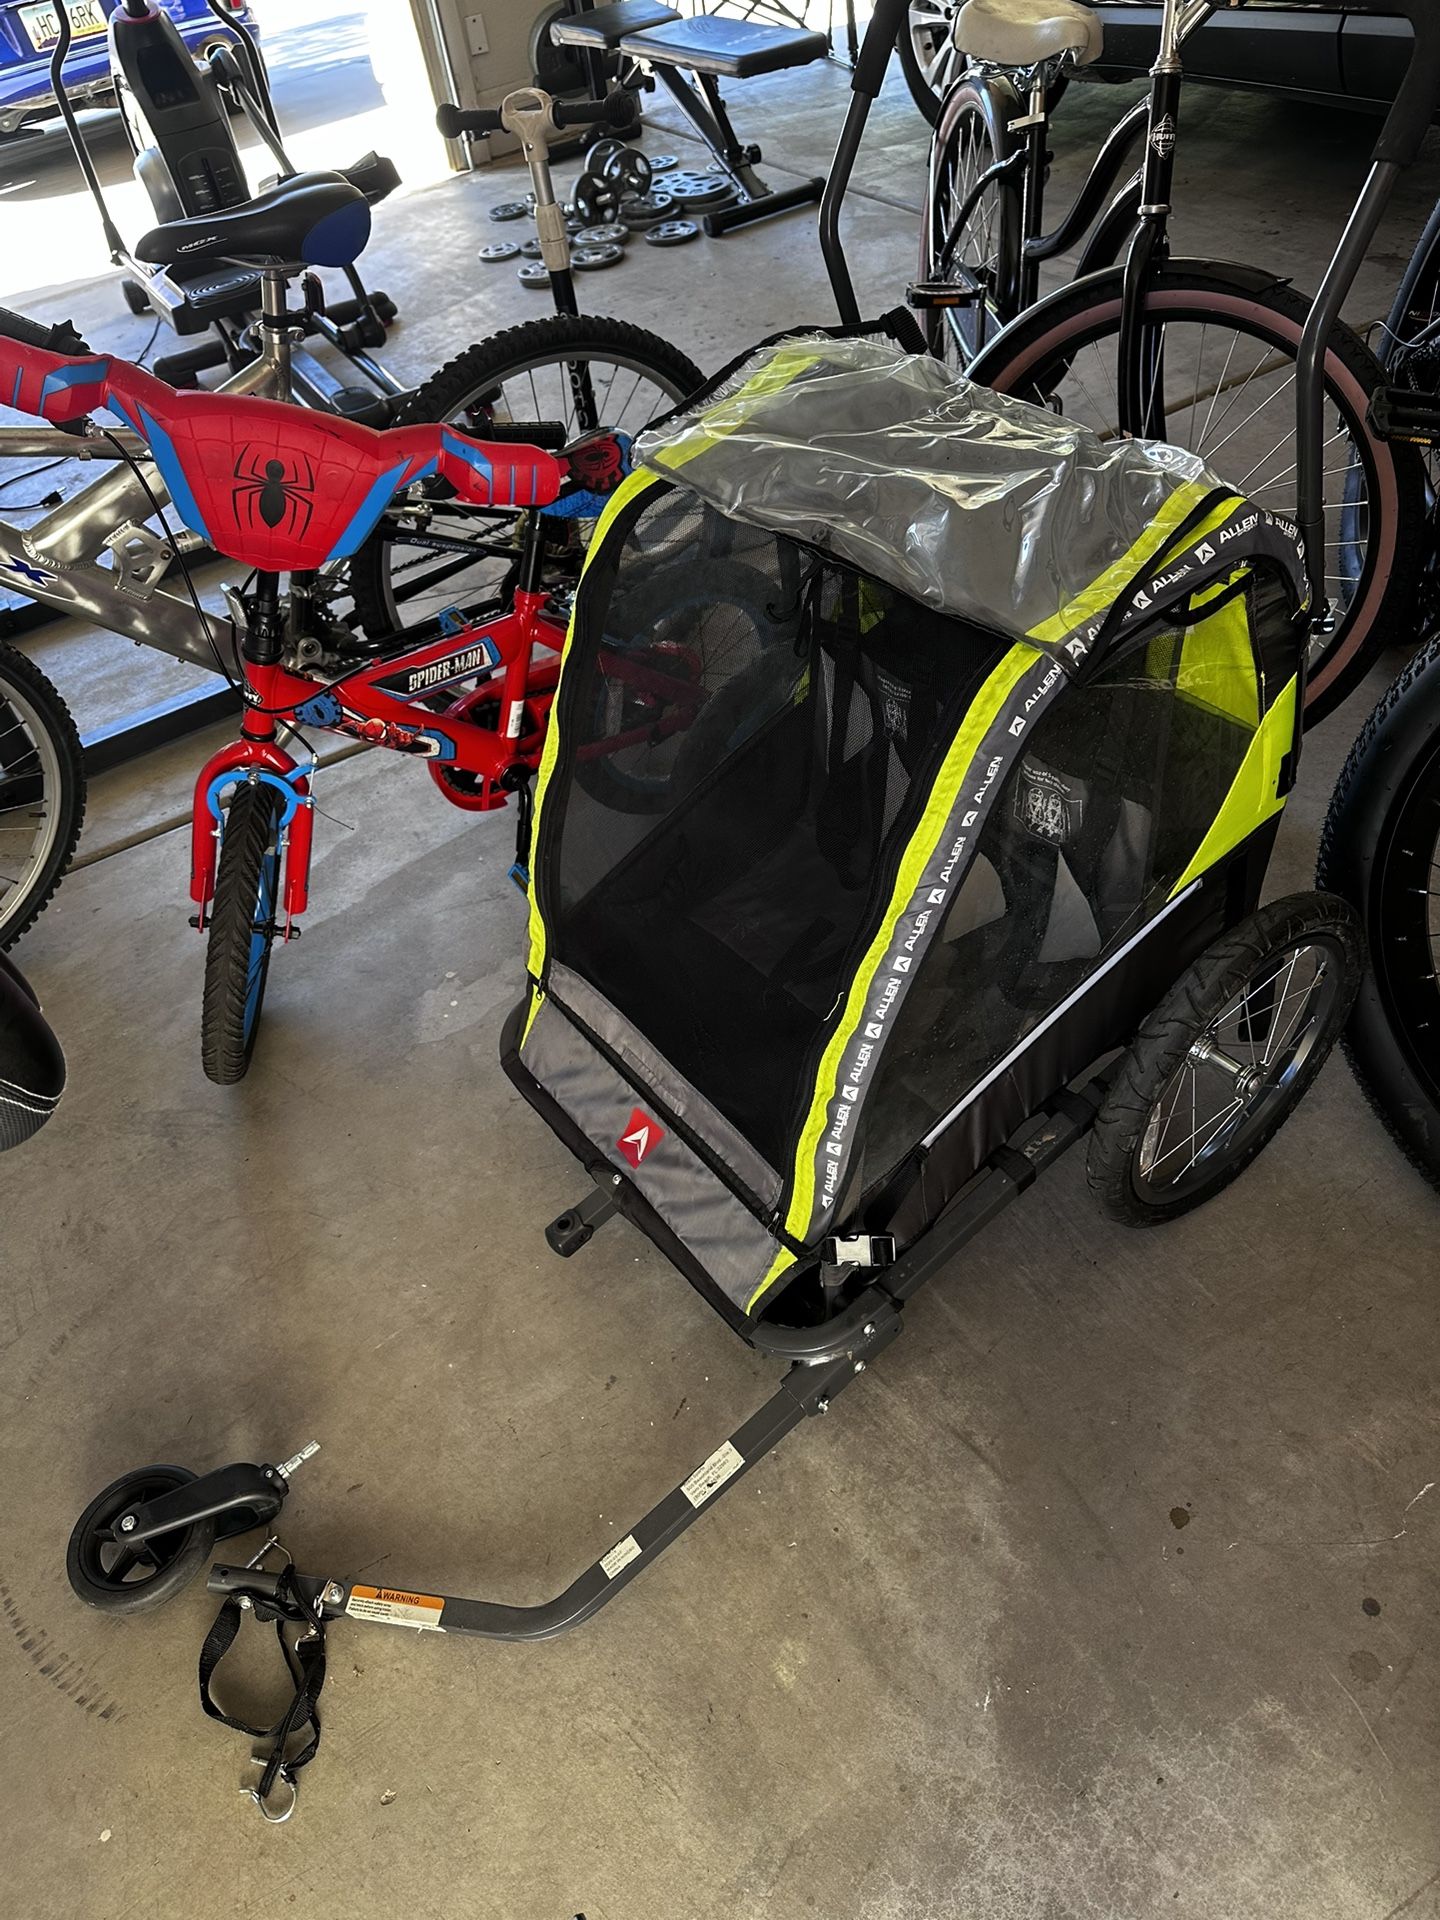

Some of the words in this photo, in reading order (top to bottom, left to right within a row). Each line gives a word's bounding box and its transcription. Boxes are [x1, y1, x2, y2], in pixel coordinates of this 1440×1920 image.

[1220, 512, 1258, 544] ALLEN
[1275, 517, 1299, 537] ALLEN
[408, 648, 481, 692] SPIDER-MAN
[1024, 663, 1062, 712] ALLEN
[973, 756, 1003, 804] ALLEN
[940, 836, 966, 883] ALLEN
[875, 978, 900, 1019] ALLEN
[849, 1044, 873, 1083] ALLEN
[831, 1104, 849, 1140] ALLEN
[824, 1160, 837, 1194] ALLEN
[383, 1591, 420, 1605] WARNING
